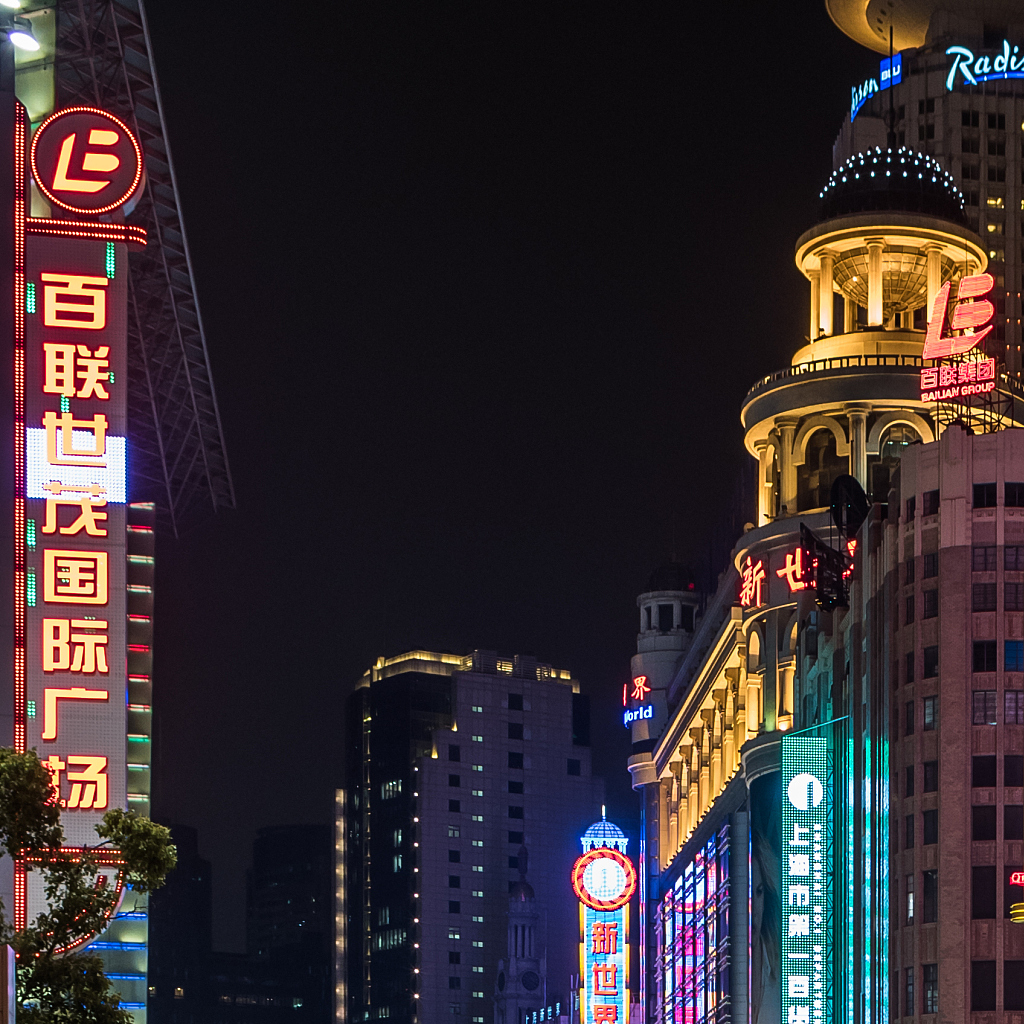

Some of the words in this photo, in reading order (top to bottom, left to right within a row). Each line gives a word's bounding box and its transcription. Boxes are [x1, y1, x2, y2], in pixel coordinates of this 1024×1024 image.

[921, 358, 995, 391] 百联集团
[921, 387, 960, 403] BAILIAN
[961, 381, 995, 396] GROUP
[40, 272, 110, 811] 百联世茂国际广场
